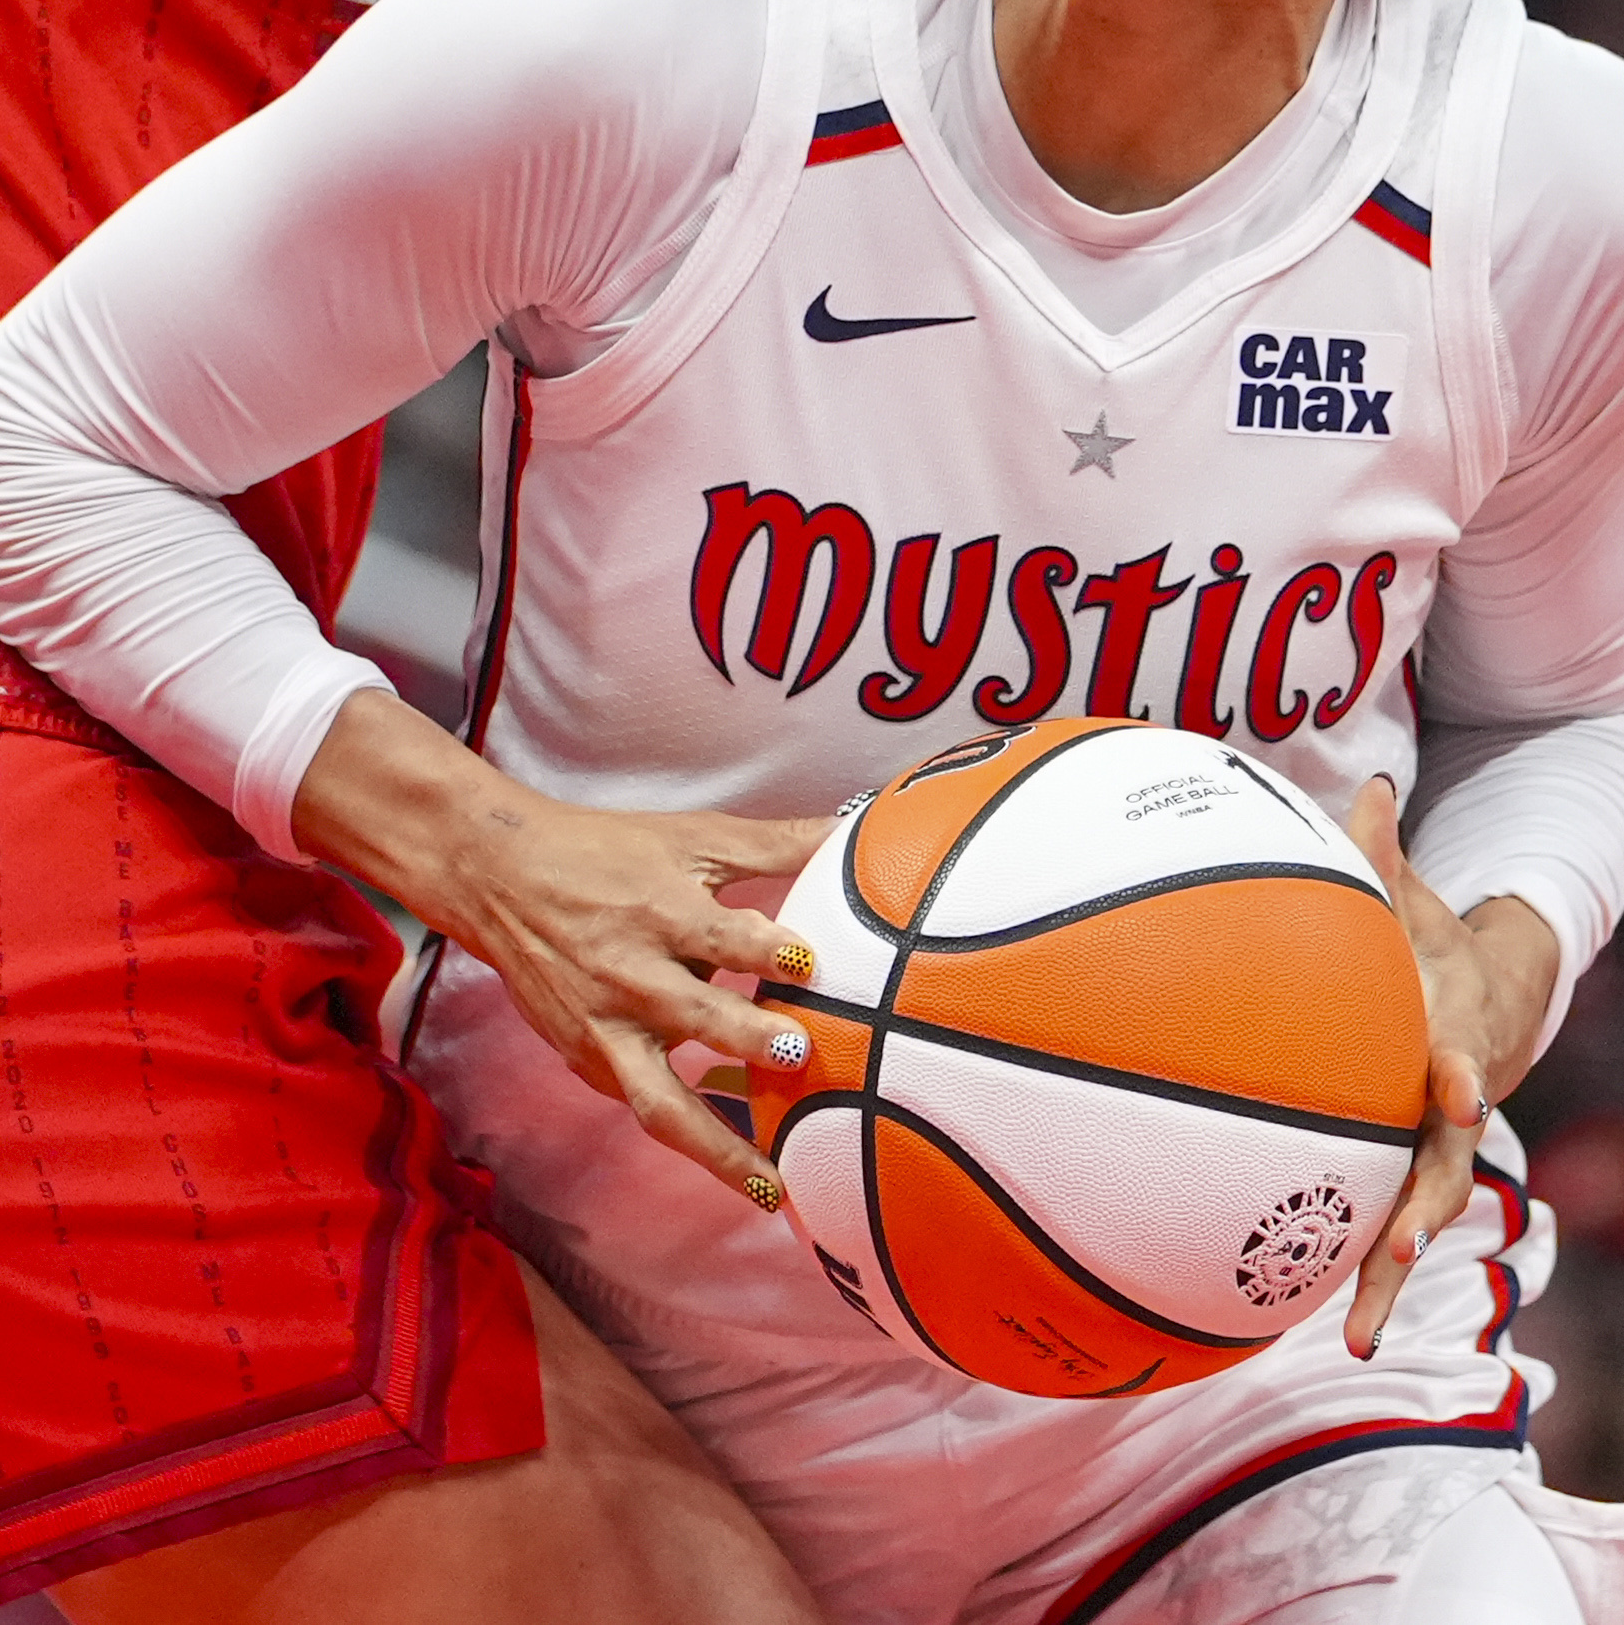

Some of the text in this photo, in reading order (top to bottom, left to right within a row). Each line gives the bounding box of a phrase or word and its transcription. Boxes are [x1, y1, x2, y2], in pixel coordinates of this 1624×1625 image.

[1240, 333, 1366, 383] CAR
[1237, 383, 1393, 435] max
[1126, 775, 1214, 803] OFFICIAL
[1126, 786, 1239, 821] GAME BALL
[1, 1039, 35, 1133] 2020
